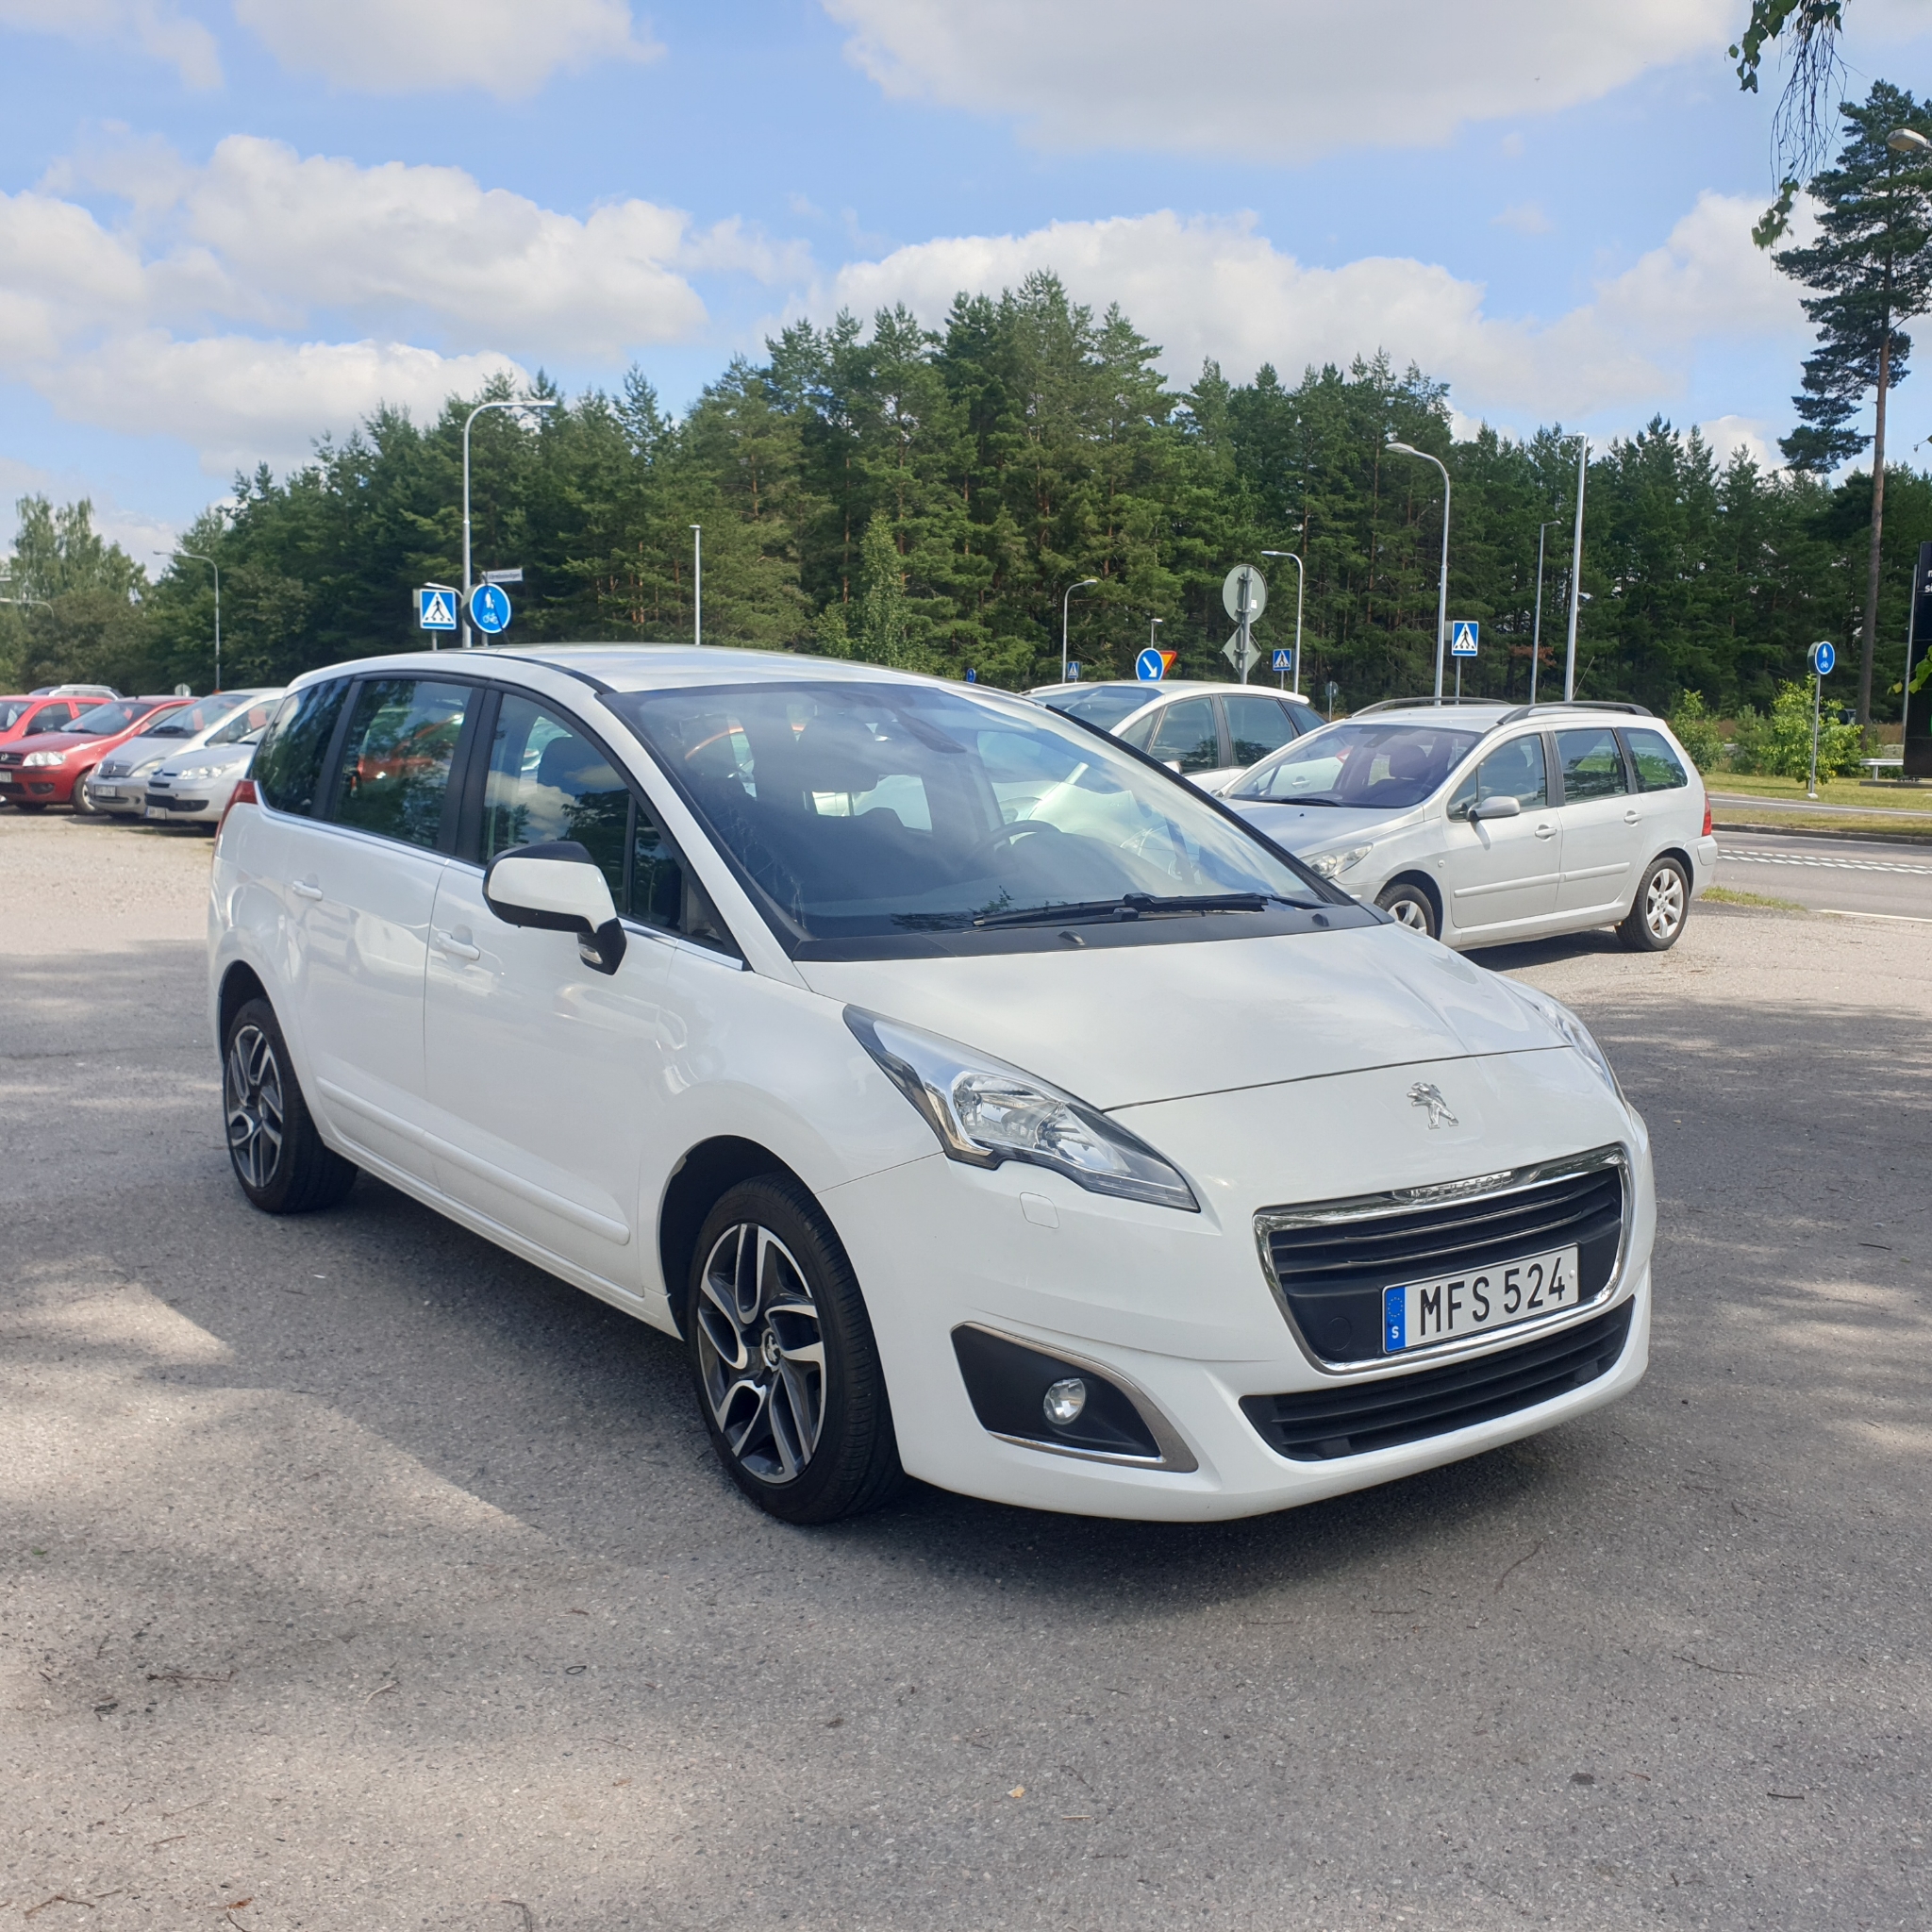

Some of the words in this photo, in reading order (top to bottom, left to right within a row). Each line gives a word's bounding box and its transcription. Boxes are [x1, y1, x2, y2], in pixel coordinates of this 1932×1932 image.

[1425, 1174, 1505, 1198] PEUGEOT
[1420, 1275, 1491, 1337] MFS
[1504, 1257, 1566, 1314] 524
[1391, 1325, 1400, 1340] S
